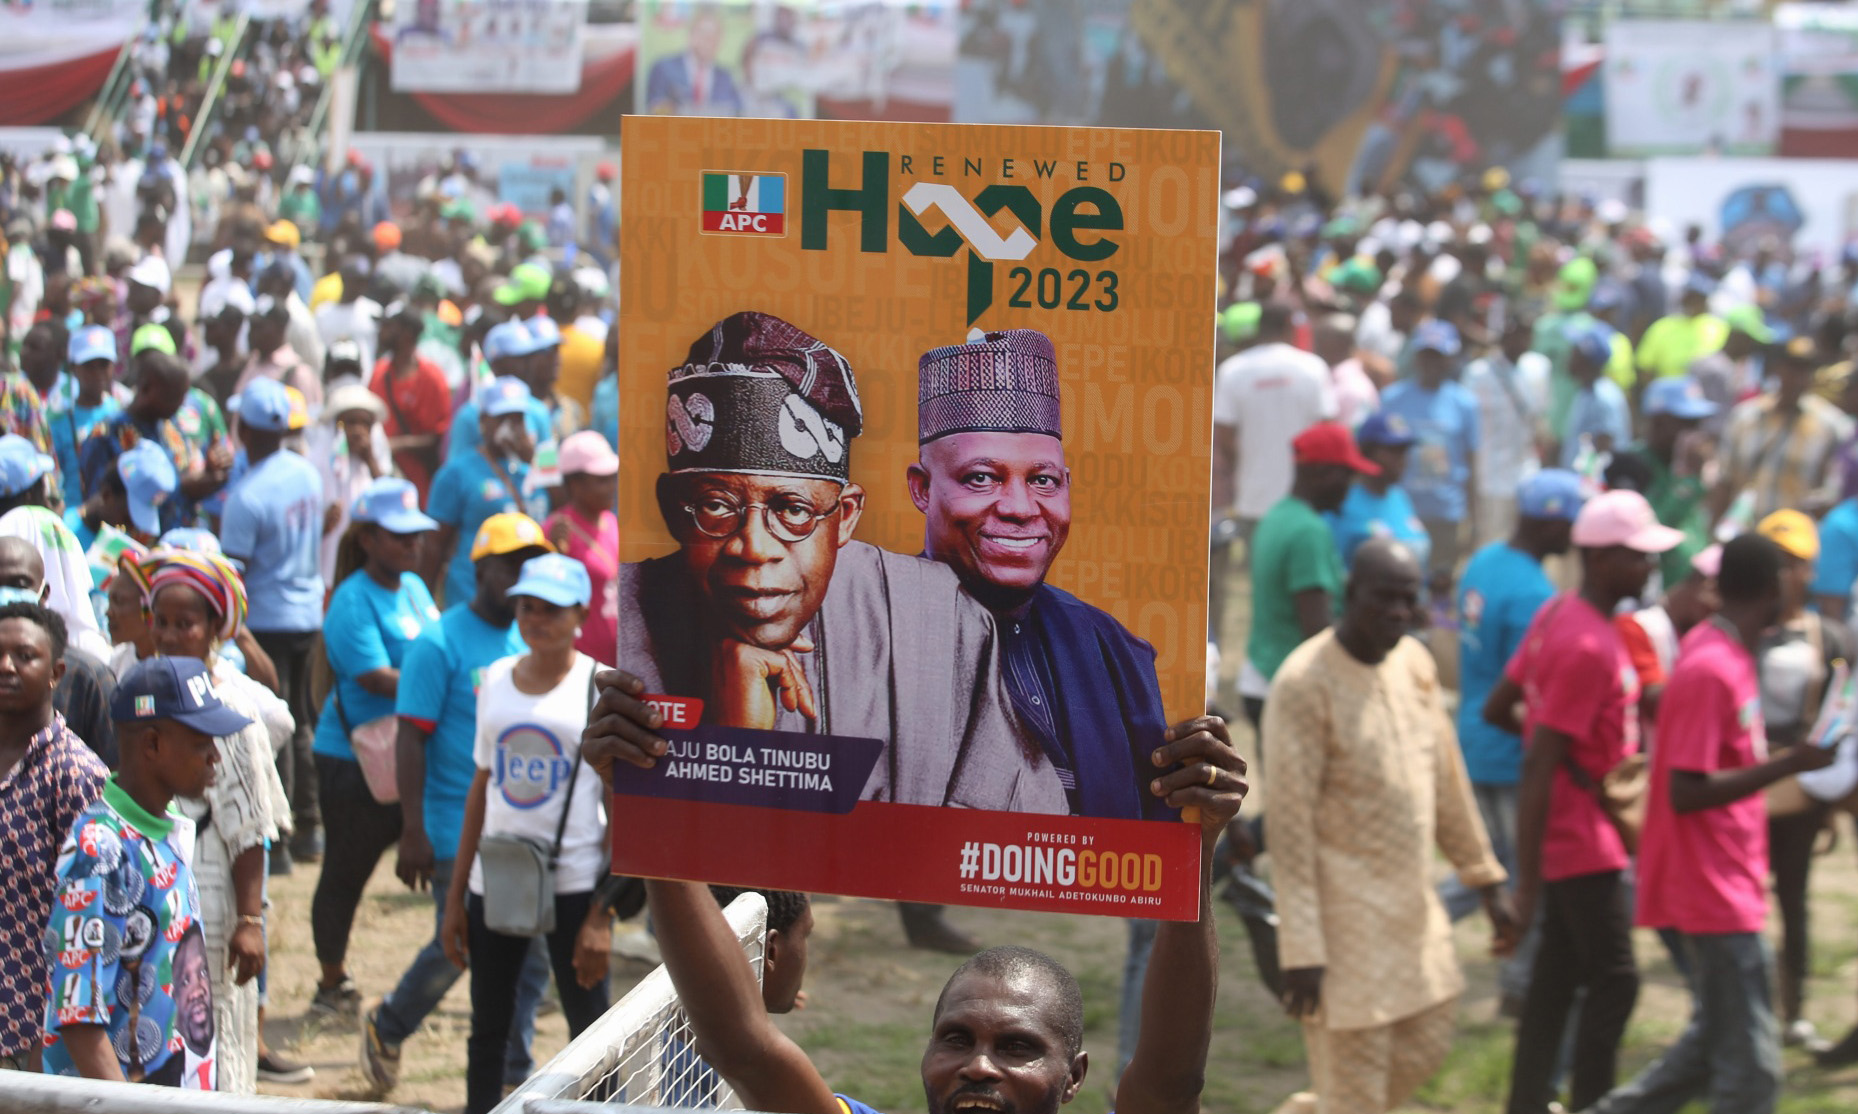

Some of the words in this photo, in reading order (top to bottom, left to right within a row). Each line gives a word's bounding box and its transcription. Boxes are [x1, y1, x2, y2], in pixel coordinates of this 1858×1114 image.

[901, 154, 1126, 182] RENEWED
[719, 214, 766, 232] APC
[1008, 266, 1119, 313] 2023
[490, 744, 573, 792] Jeep
[705, 743, 756, 765] BOLA
[760, 747, 831, 771] TINUBU
[665, 760, 733, 783] AHMED
[738, 767, 834, 792] SHETTIMA
[1027, 831, 1077, 845] POWERED
[1082, 834, 1095, 846] BY
[64, 891, 93, 908] APC
[960, 883, 1006, 895] SENATOR
[1009, 887, 1055, 899] MUKHAIL
[1058, 890, 1127, 904] ADETOKUNBO
[1130, 895, 1162, 906] ABIRU
